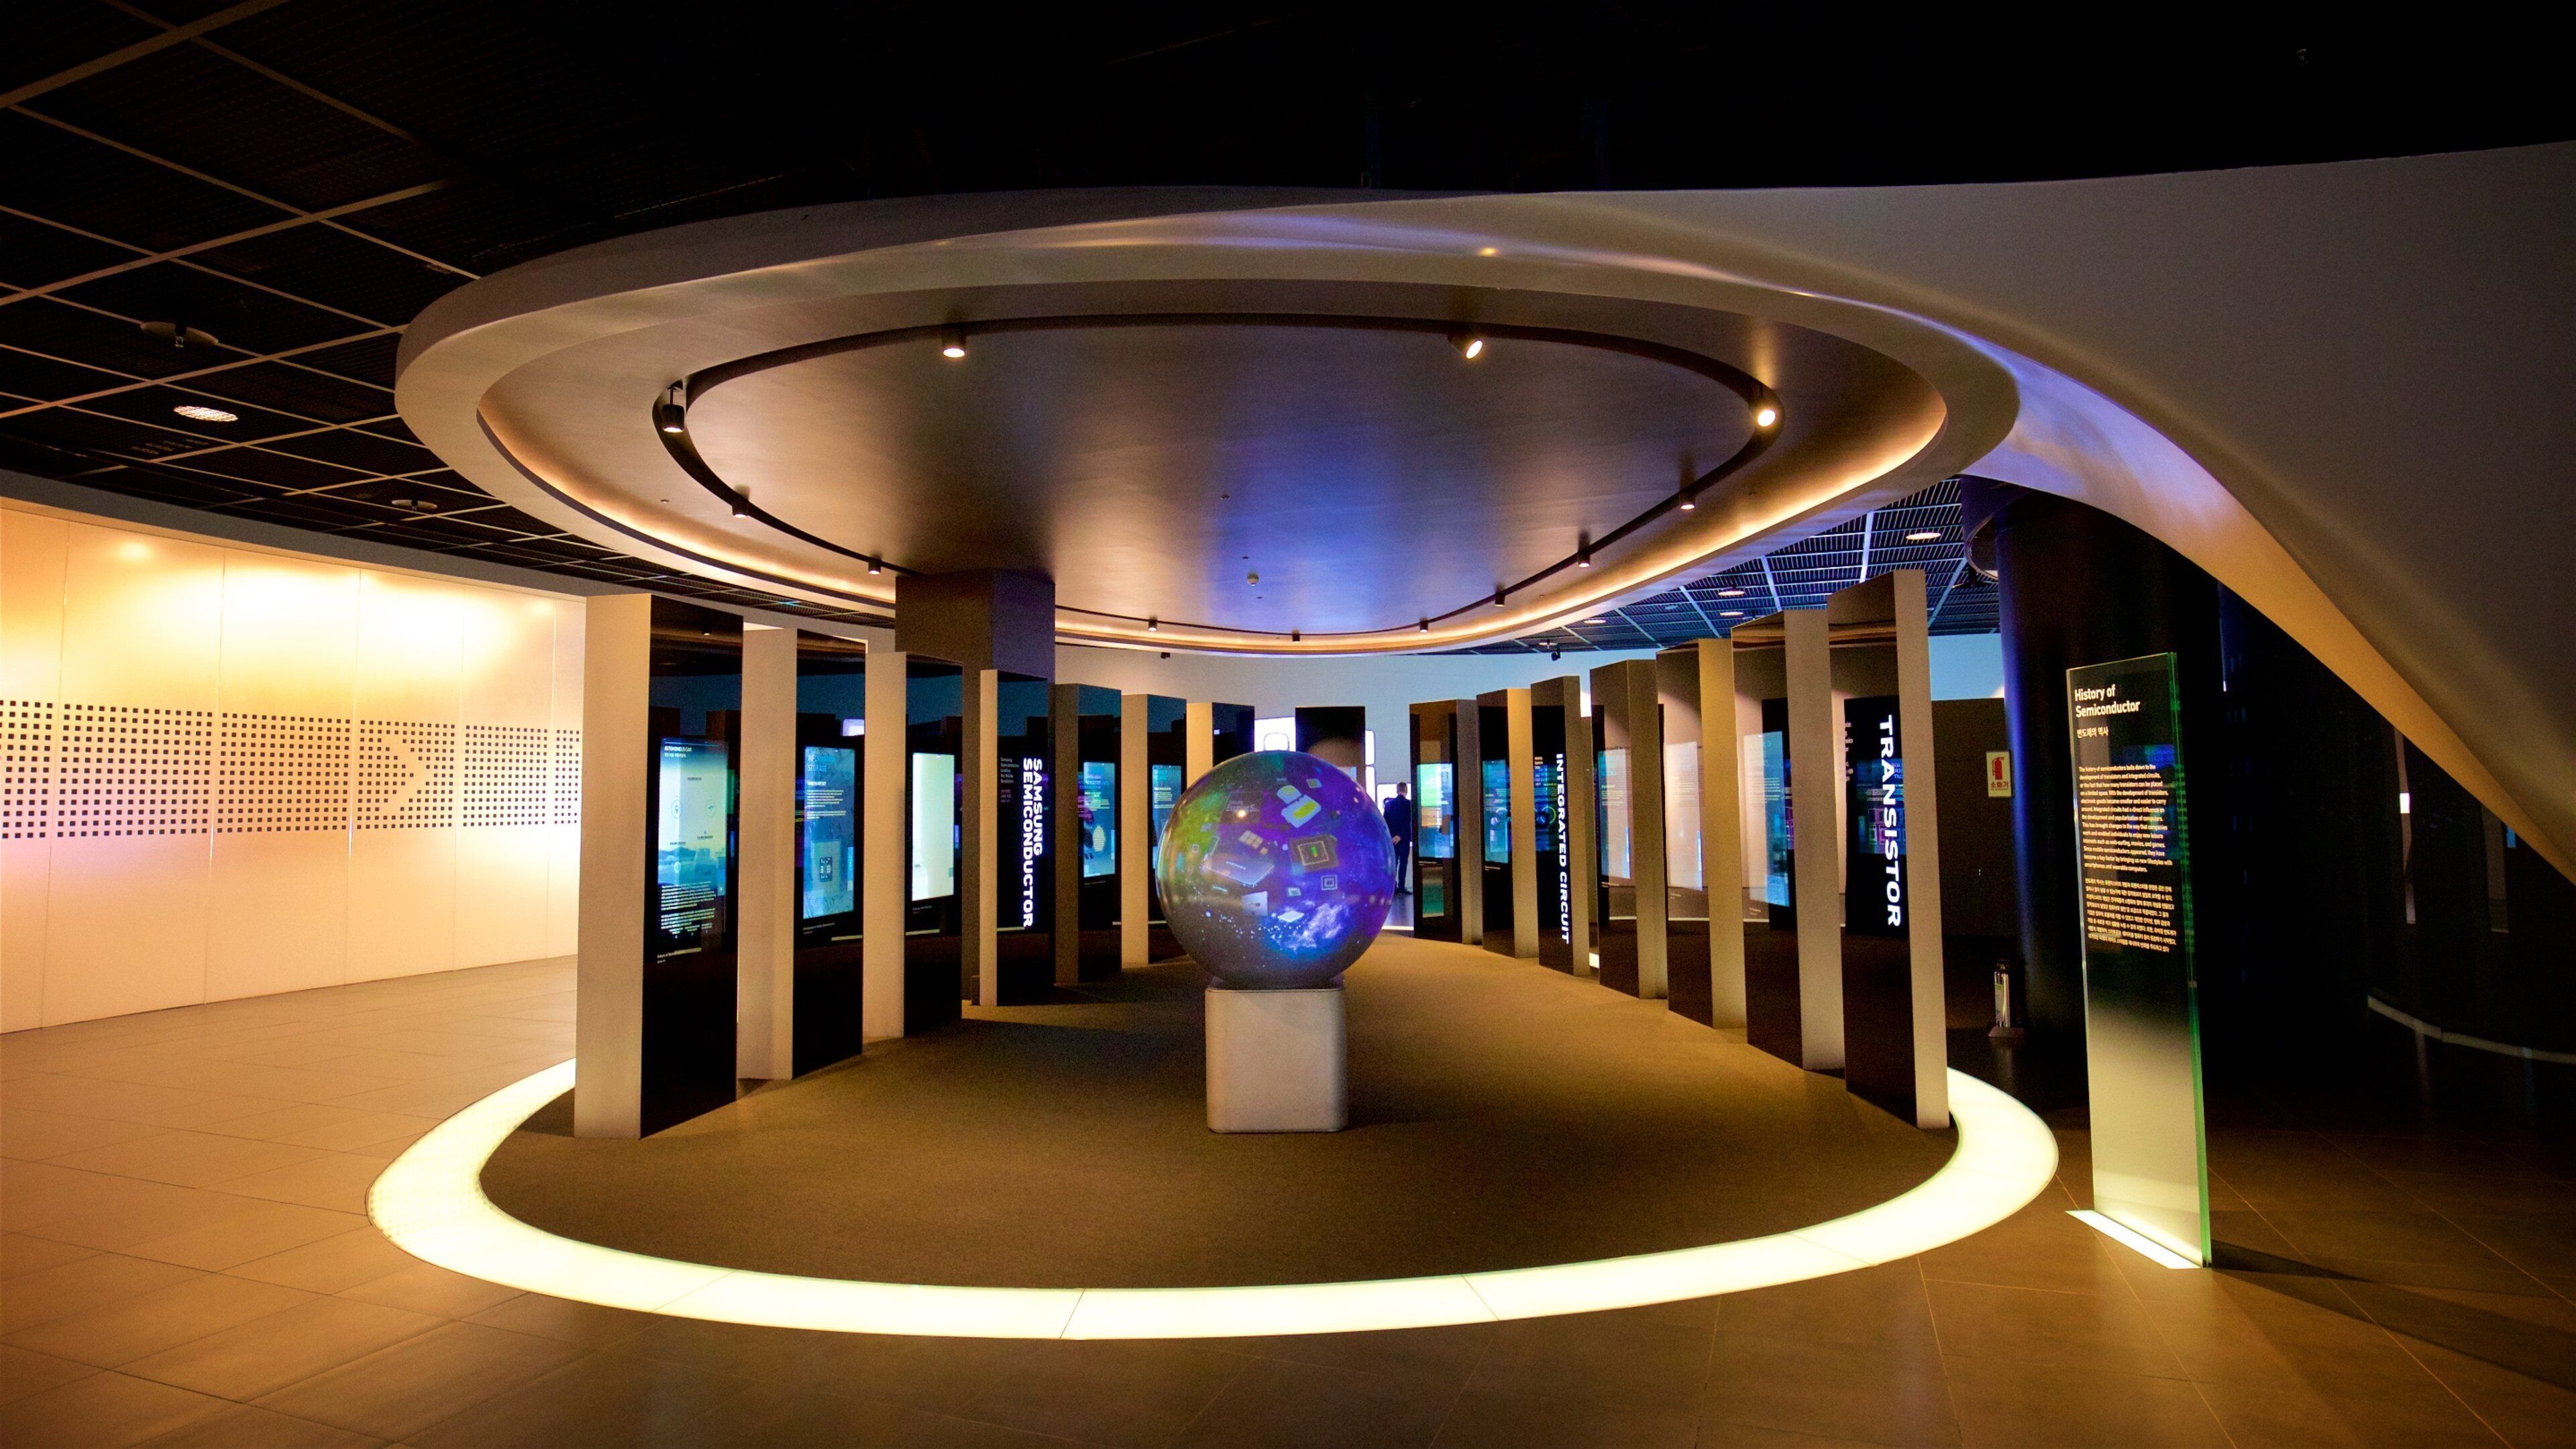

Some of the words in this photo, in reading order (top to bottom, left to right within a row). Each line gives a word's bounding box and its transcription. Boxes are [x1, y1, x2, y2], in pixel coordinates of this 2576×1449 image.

[2074, 688, 2104, 702] History
[2106, 684, 2115, 697] of
[2076, 700, 2140, 718] Semiconductor
[1024, 759, 1032, 926] SEMICONDUCTOR
[1034, 759, 1042, 855] SAMSUNG
[1556, 753, 1567, 867] INTEGRATED
[1880, 714, 1900, 926] TRANSISTOR
[1560, 872, 1569, 944] CIRCUIT
